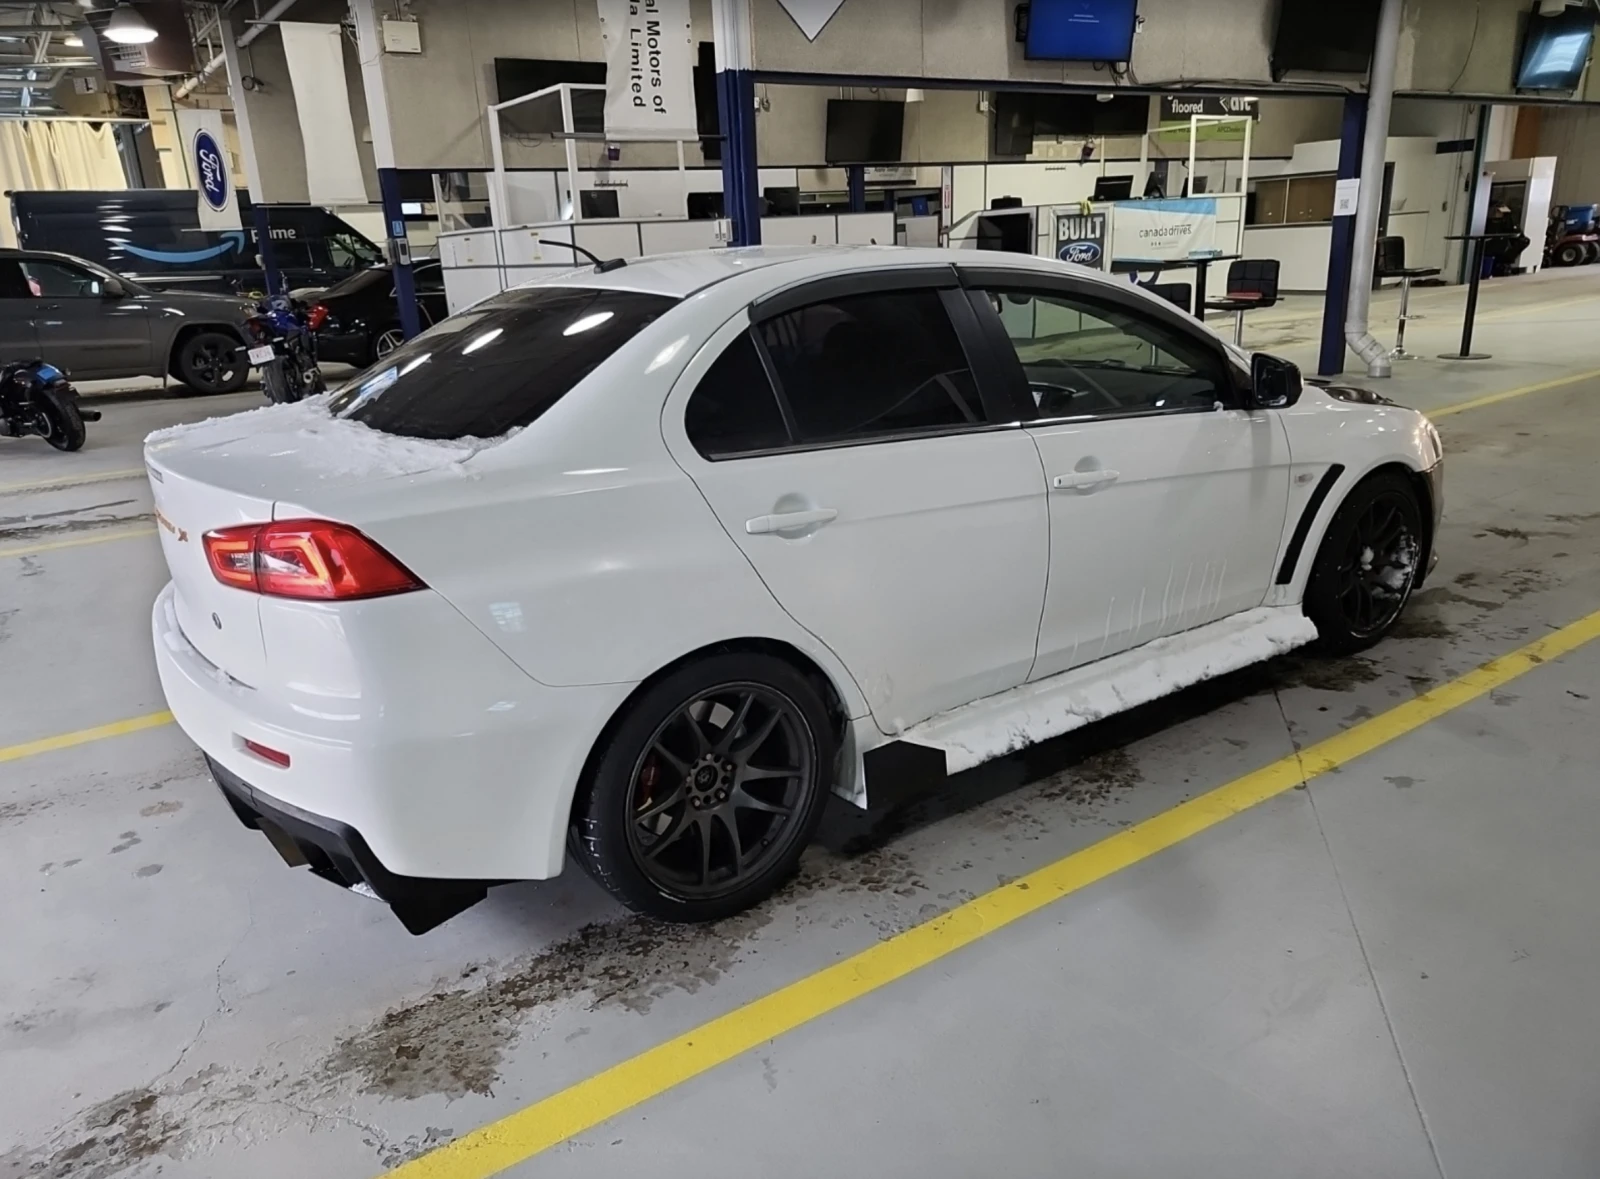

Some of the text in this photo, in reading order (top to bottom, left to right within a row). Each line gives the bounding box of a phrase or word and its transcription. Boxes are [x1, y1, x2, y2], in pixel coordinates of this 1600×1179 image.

[646, 20, 661, 88] Motors
[630, 28, 647, 107] Limited
[652, 95, 667, 114] of
[1171, 99, 1204, 113] floored
[199, 149, 221, 193] Ford
[250, 225, 297, 243] pime
[1058, 216, 1103, 241] BUILT
[1066, 245, 1094, 262] Ford
